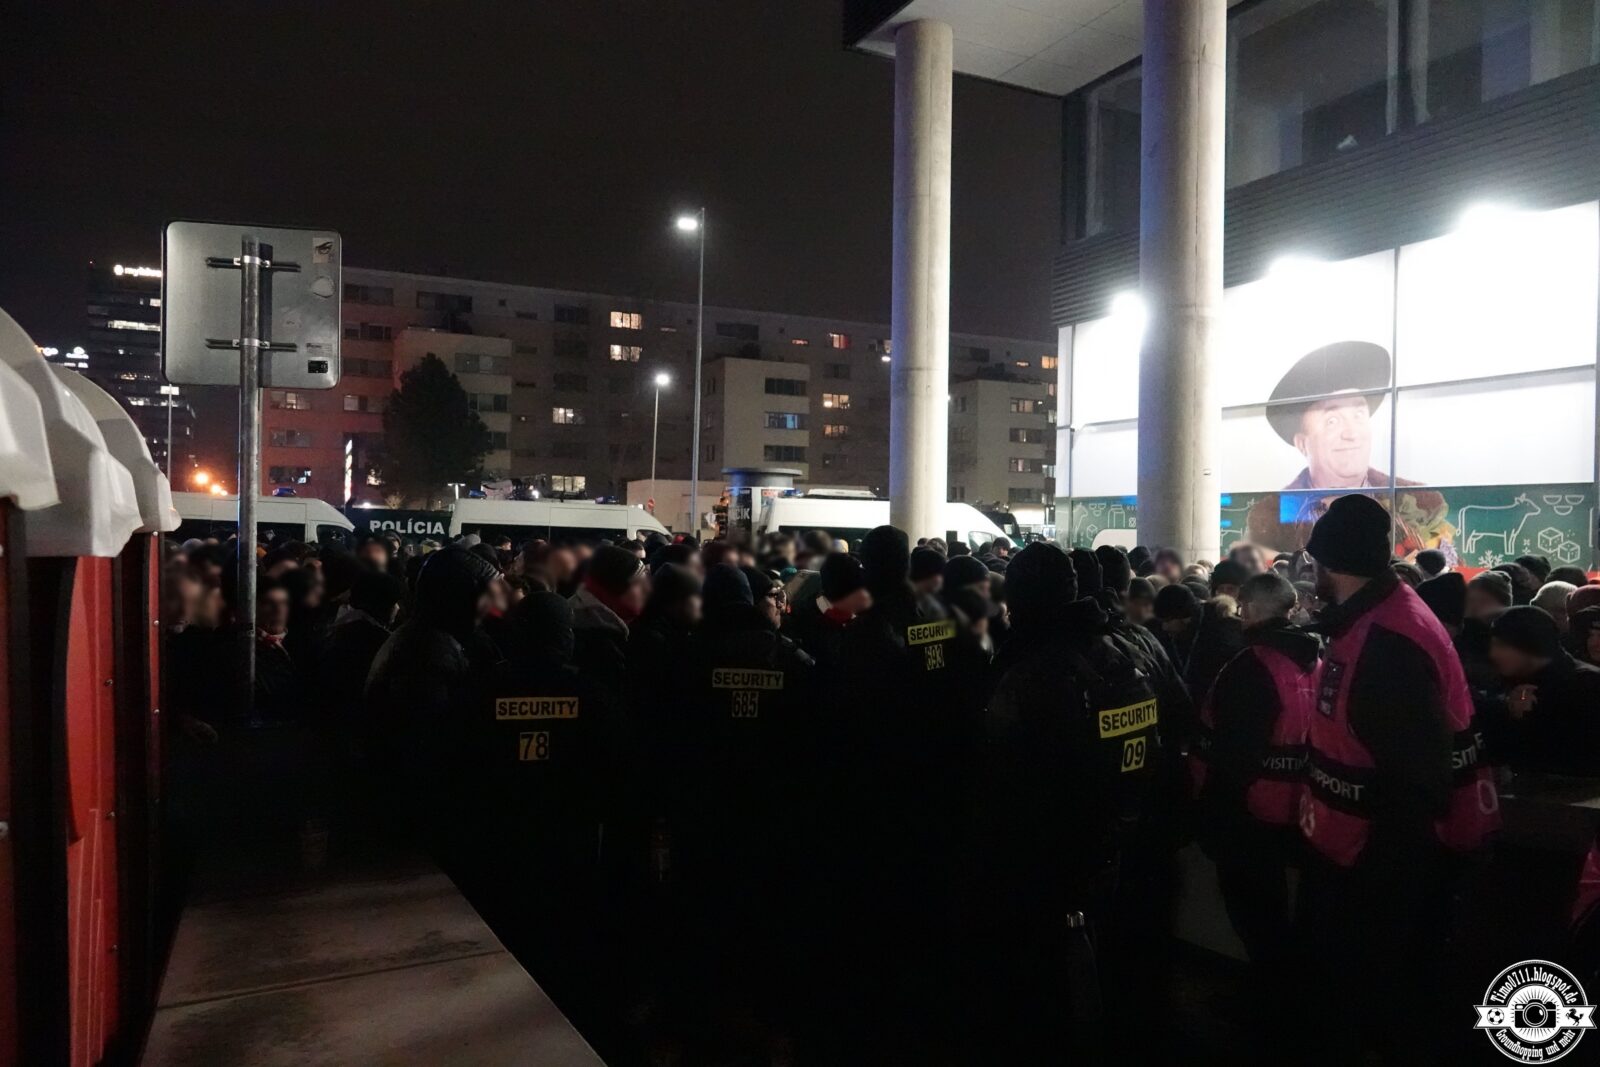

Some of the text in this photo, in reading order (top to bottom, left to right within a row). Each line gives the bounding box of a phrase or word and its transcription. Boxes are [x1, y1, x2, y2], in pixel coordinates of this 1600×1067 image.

[369, 518, 445, 534] POLÍCIA
[910, 623, 953, 641] SECURI
[713, 671, 782, 687] SECURITY
[497, 700, 577, 716] SECURITY
[733, 692, 757, 716] 685
[1101, 702, 1157, 732] SECURITY
[520, 733, 548, 759] 78
[1123, 740, 1145, 768] 09
